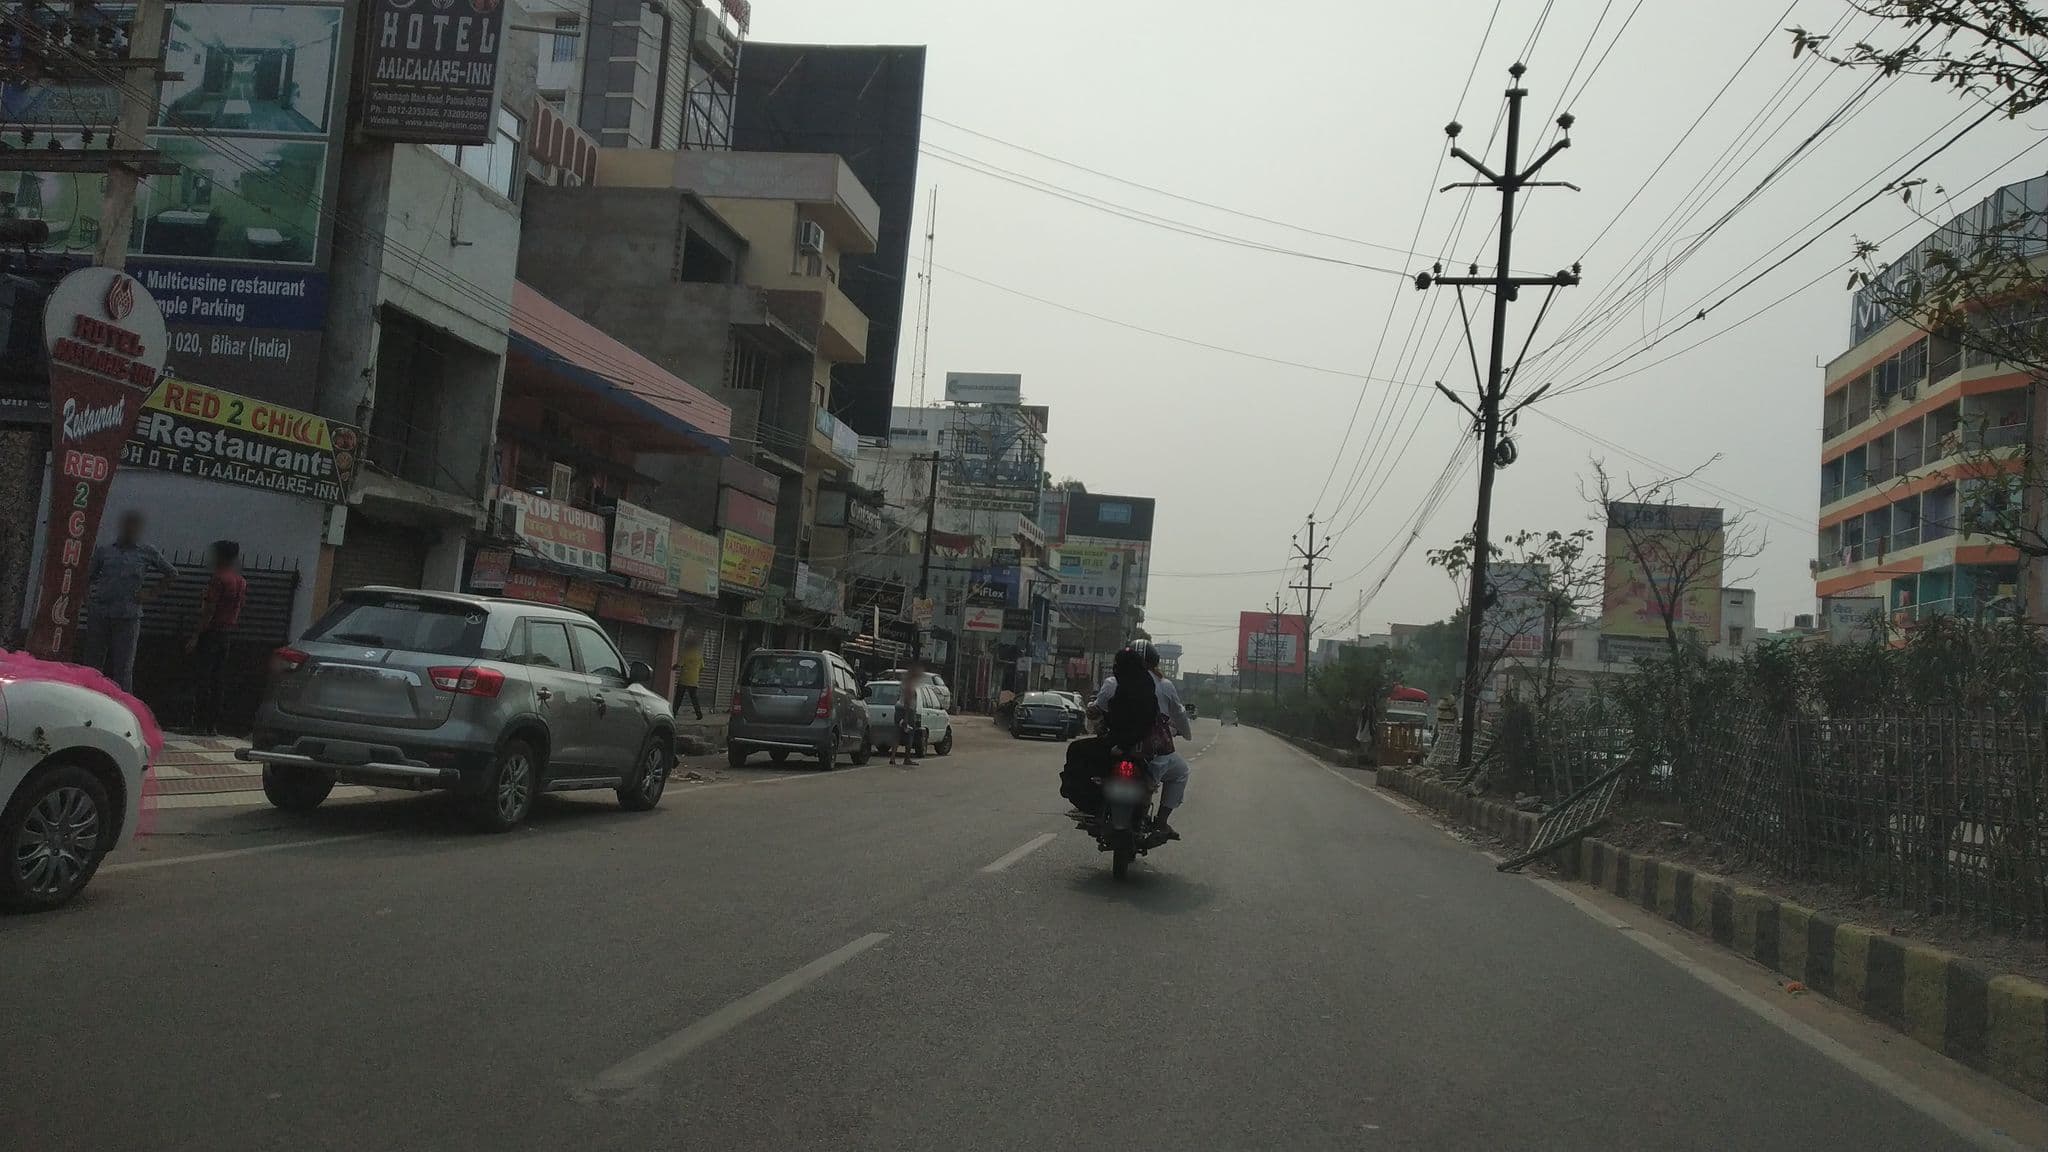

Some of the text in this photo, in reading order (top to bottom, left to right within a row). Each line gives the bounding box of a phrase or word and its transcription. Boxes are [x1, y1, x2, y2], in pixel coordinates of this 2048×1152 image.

[380, 11, 496, 54] HOTEL
[147, 270, 305, 296] Multicusine restaurant
[192, 297, 245, 322] Parking
[211, 334, 246, 356] Bihar
[249, 336, 291, 363] (India)
[62, 393, 124, 444] Restaurant
[164, 383, 221, 418] RED
[227, 399, 243, 425] 2
[149, 412, 322, 477] Restaurant
[63, 450, 108, 481] RED
[73, 481, 90, 508] 2
[563, 508, 605, 534] TUBULAR
